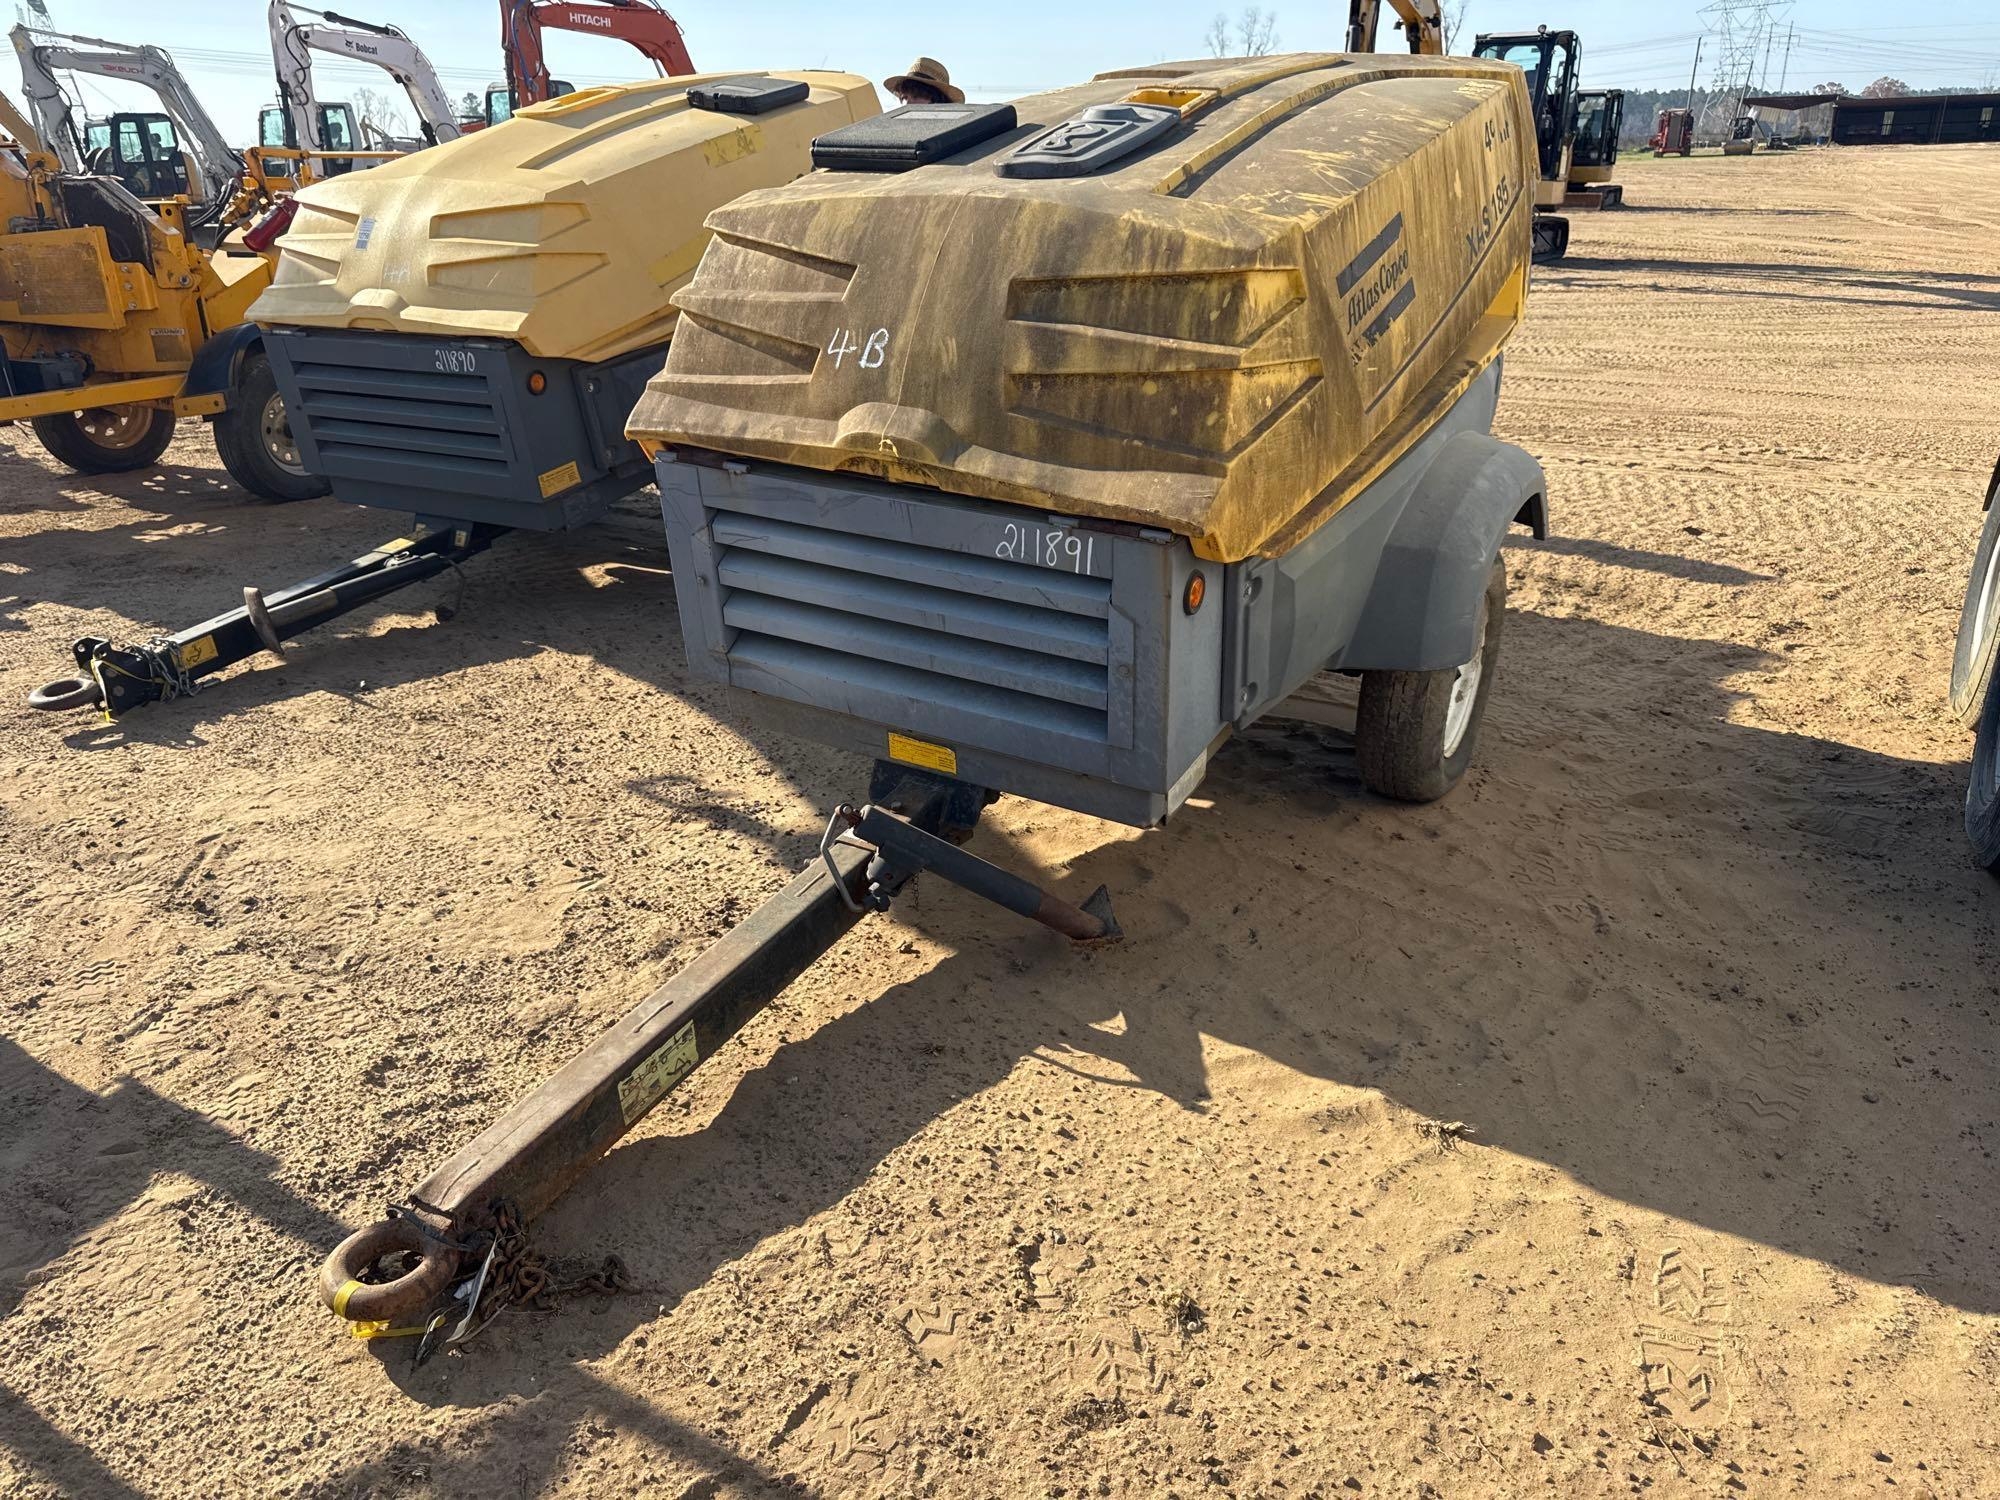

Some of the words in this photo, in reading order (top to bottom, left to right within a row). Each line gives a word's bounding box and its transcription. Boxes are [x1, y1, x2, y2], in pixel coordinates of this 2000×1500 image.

[569, 12, 611, 27] HITACHI
[355, 42, 377, 55] Bobcat
[1491, 175, 1509, 221] 185
[1347, 281, 1380, 335] Atlas
[434, 349, 476, 372] 211890
[827, 327, 889, 369] 4-B
[995, 523, 1094, 575] 211891
